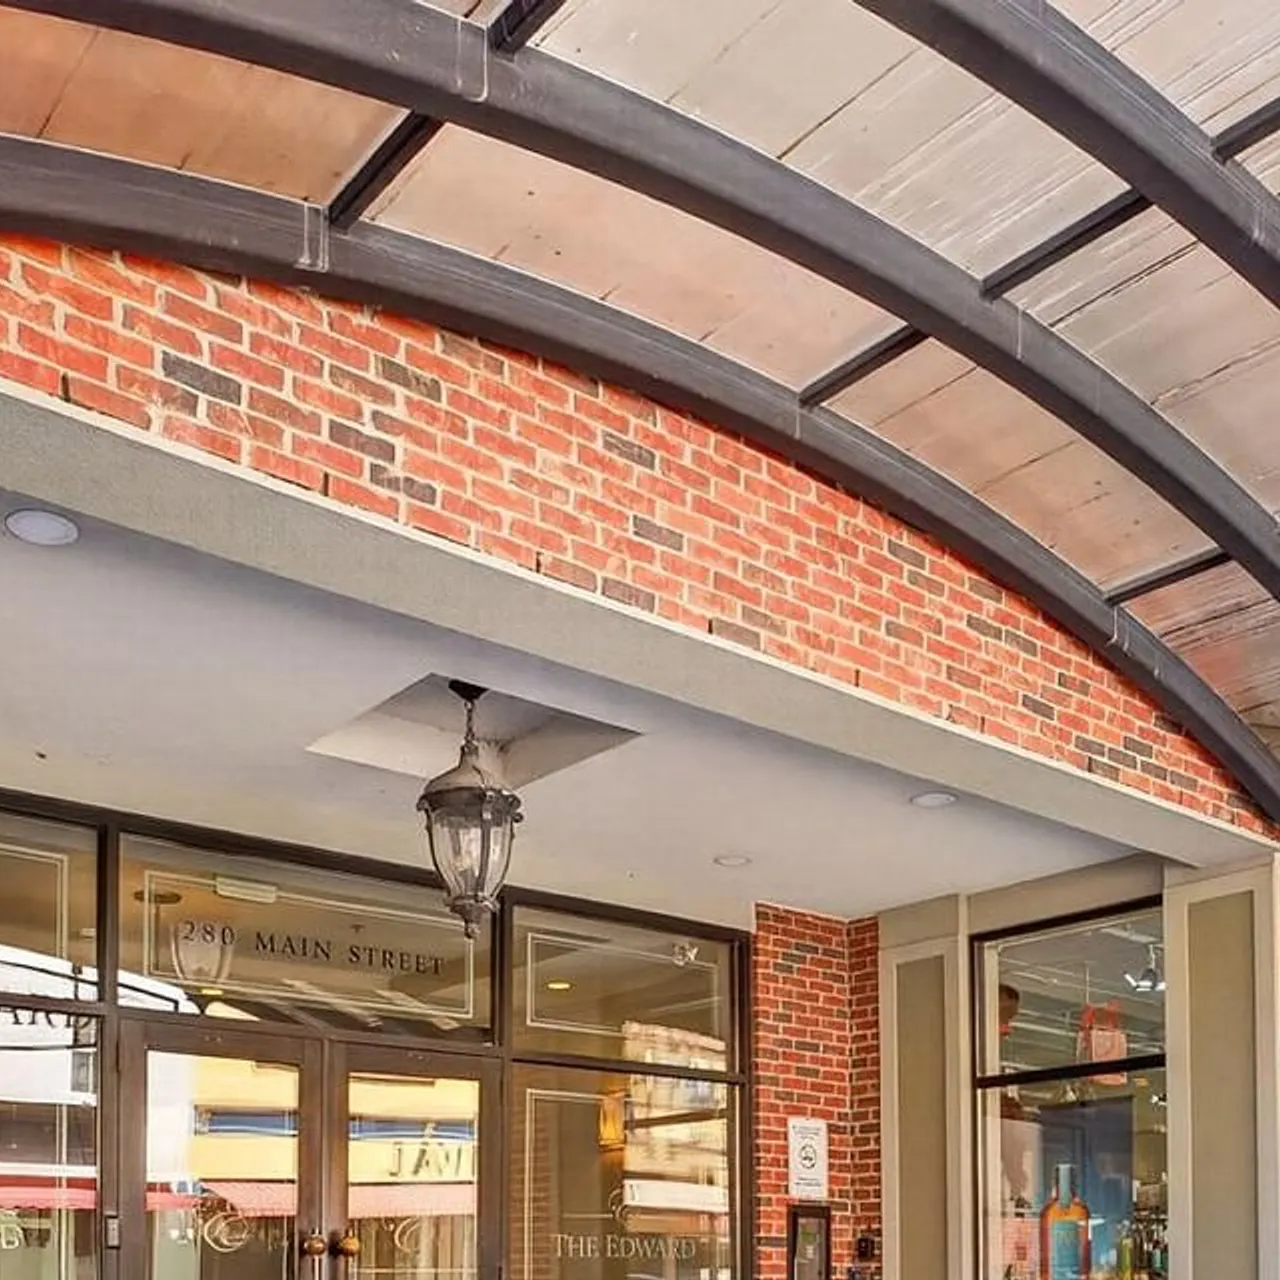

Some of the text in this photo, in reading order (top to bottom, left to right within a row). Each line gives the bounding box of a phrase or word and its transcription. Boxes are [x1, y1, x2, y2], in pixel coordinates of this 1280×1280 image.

[182, 920, 445, 975] 280 MAIN STREET
[554, 1233, 696, 1259] THE EDWARD
